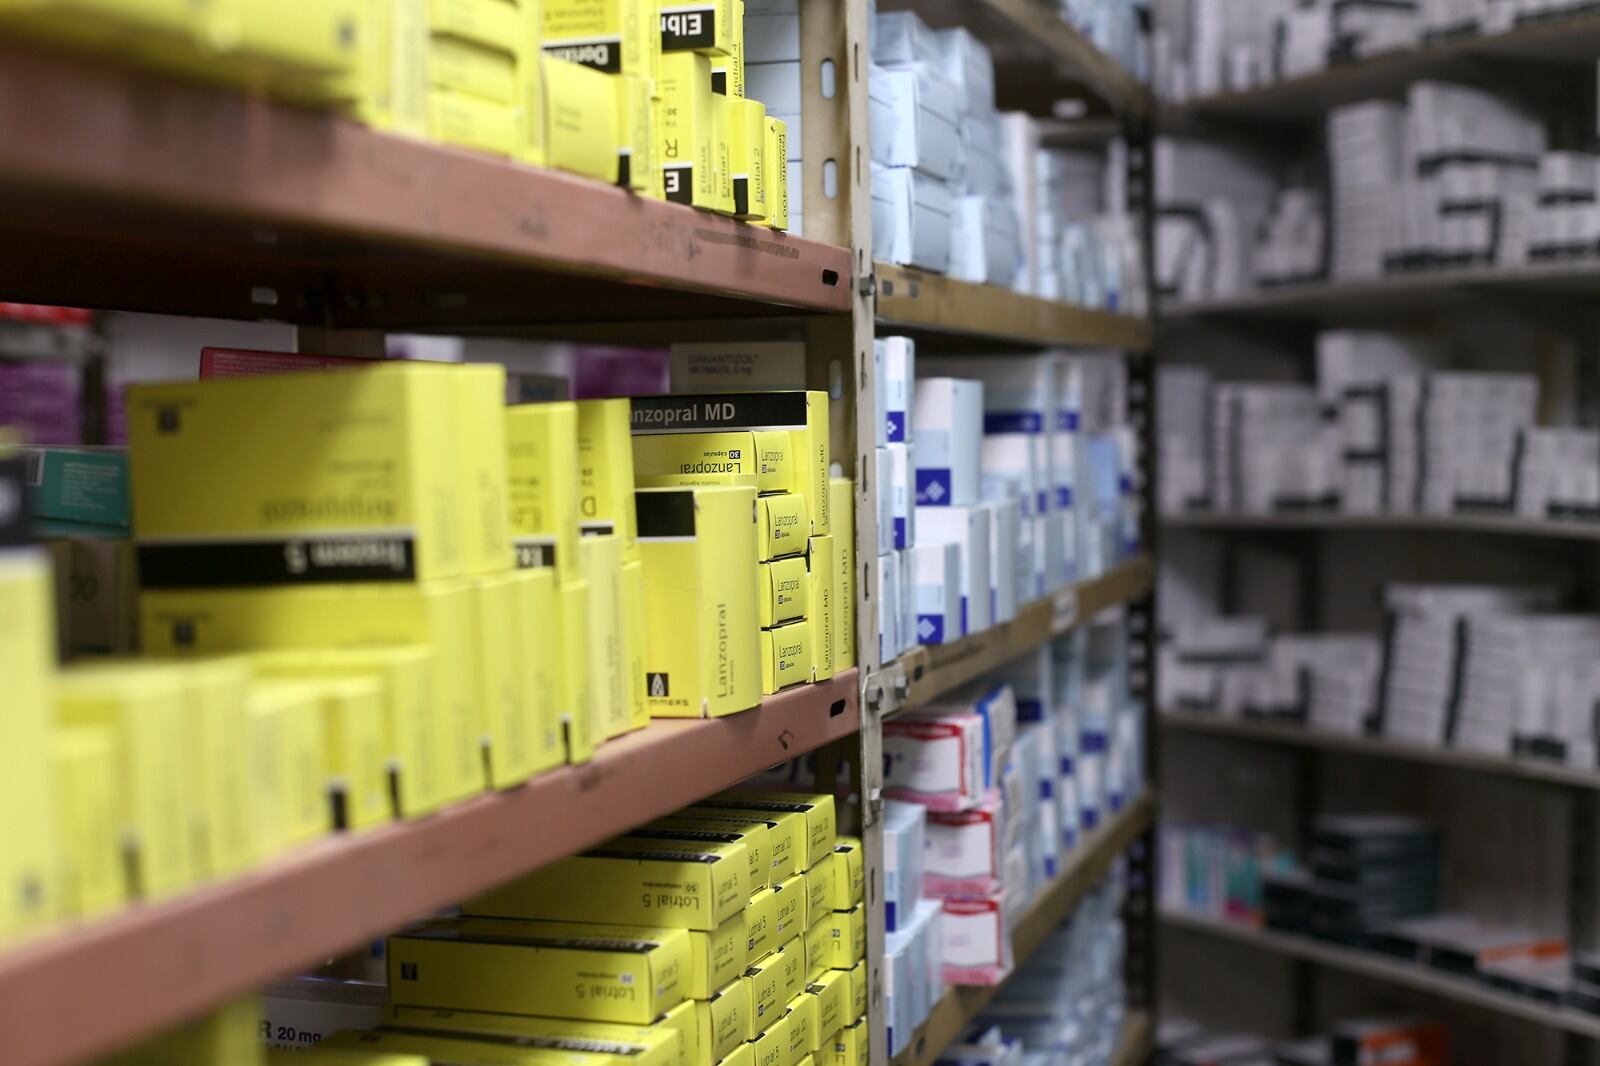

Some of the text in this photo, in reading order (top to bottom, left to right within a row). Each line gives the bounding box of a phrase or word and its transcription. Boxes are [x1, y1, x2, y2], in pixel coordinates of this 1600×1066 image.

[661, 14, 702, 36] Elbr
[705, 403, 736, 421] MD
[680, 462, 741, 474] Lanzopral
[716, 603, 728, 698] Lanzopral
[642, 893, 700, 910] Lotrial 5
[590, 985, 635, 1001] Lotrial
[277, 1026, 296, 1041] 20
